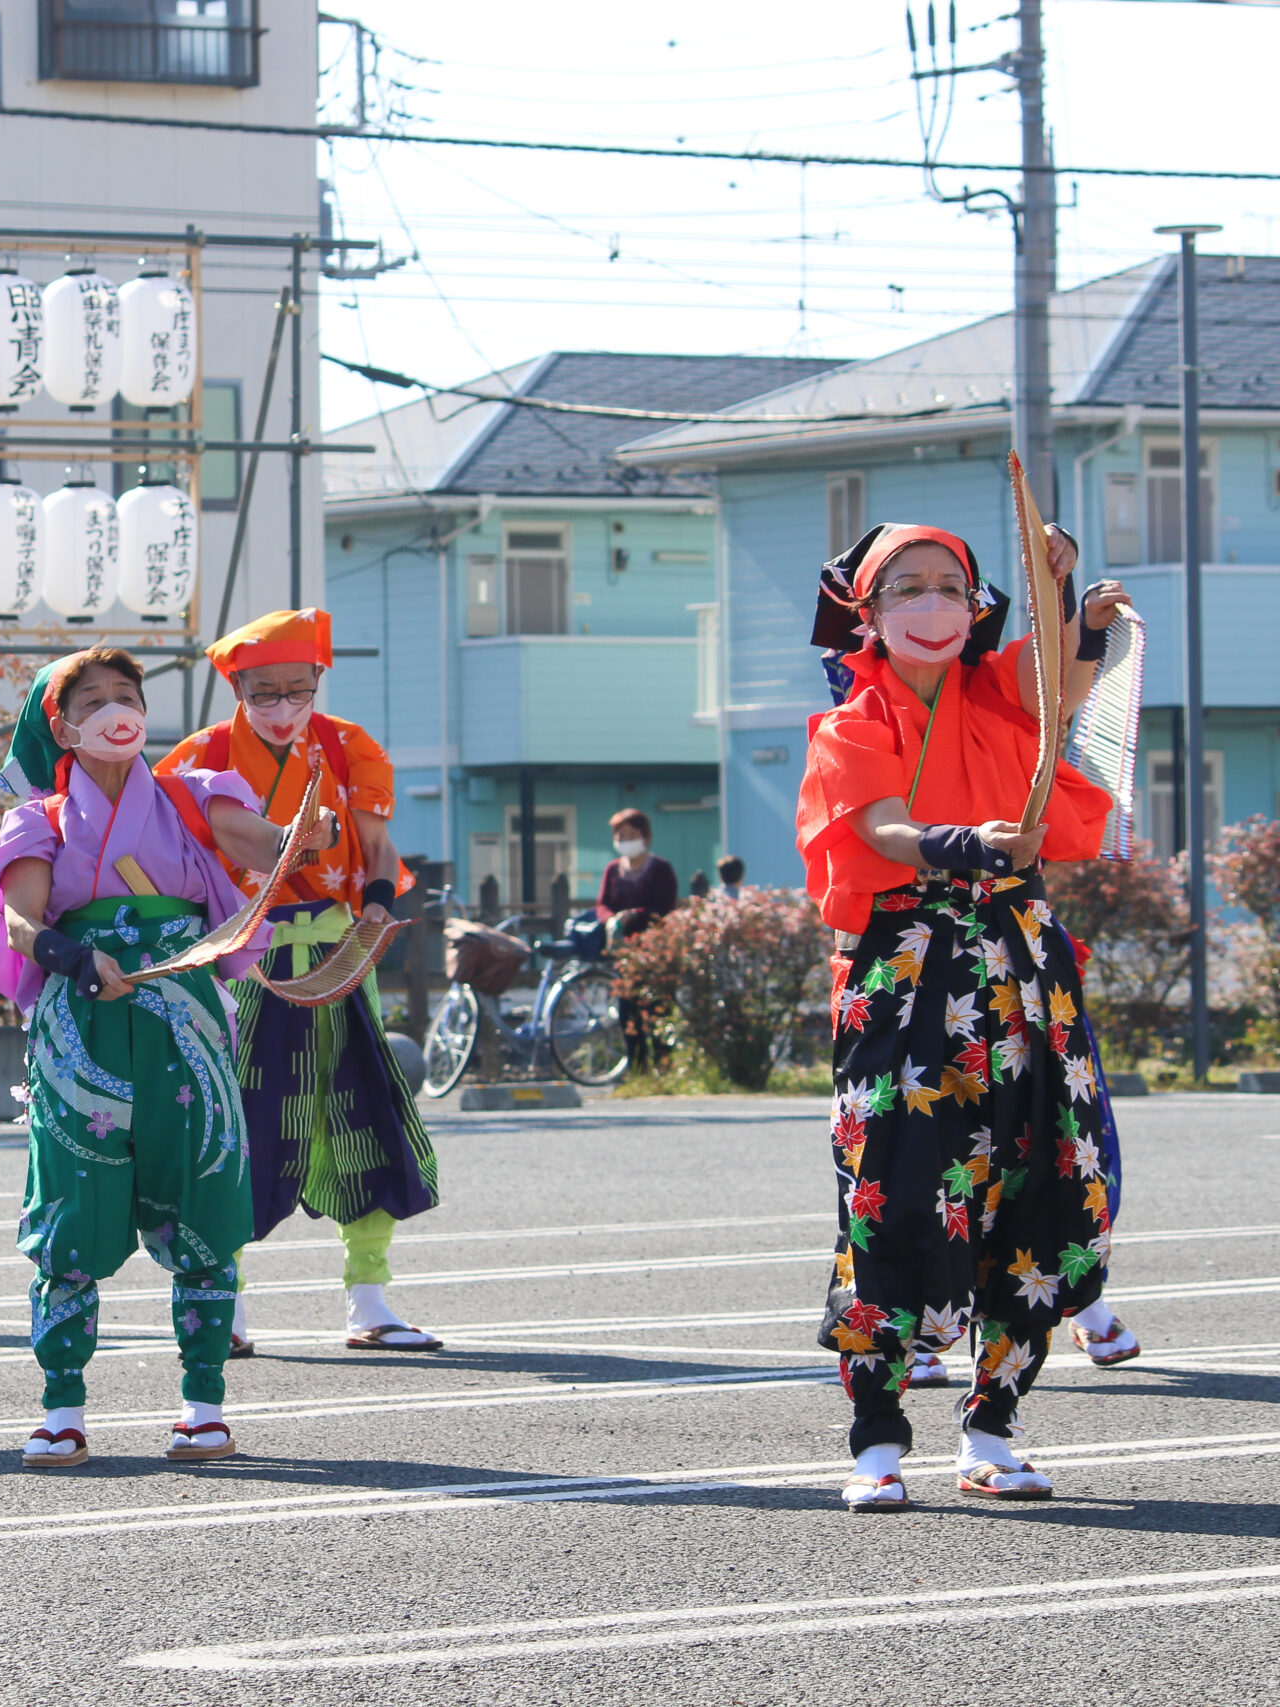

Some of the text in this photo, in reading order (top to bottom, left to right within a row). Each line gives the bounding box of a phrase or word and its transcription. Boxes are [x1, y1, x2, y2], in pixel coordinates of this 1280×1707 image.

[7, 283, 43, 398] 照青会
[151, 331, 170, 392] 保存会
[146, 542, 169, 606] 保存会
[172, 496, 194, 603] 本庄まつり
